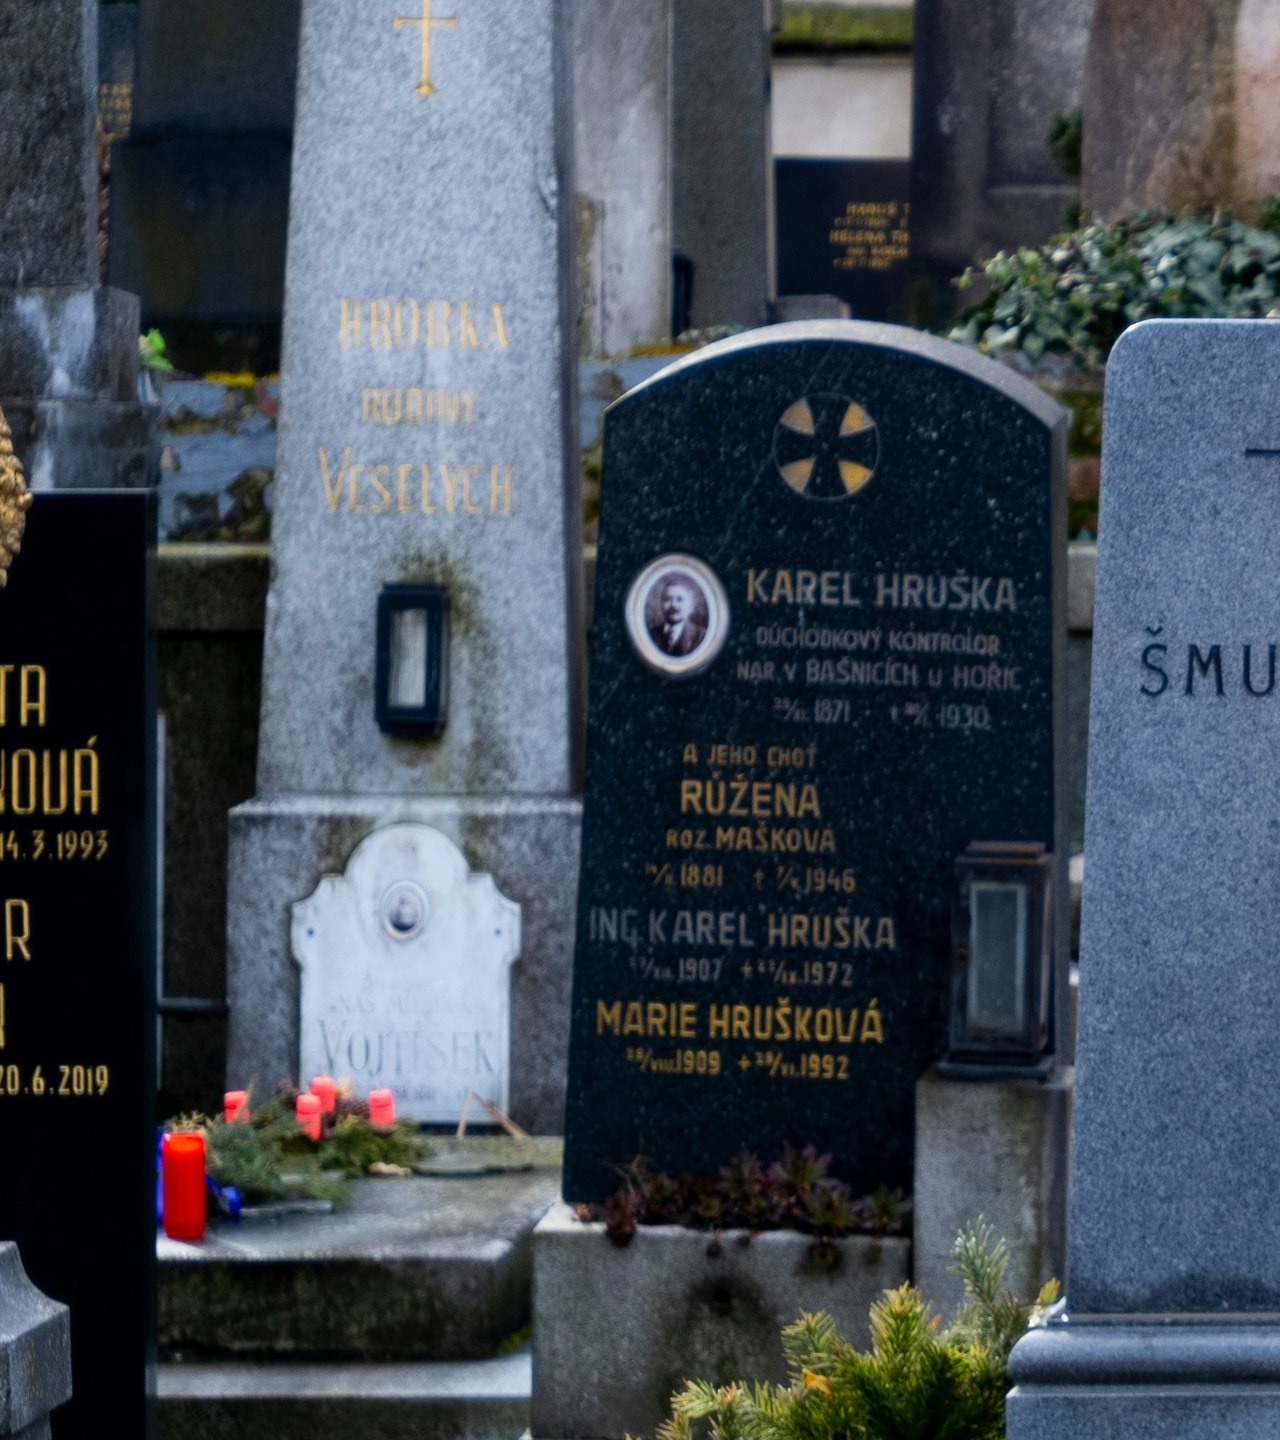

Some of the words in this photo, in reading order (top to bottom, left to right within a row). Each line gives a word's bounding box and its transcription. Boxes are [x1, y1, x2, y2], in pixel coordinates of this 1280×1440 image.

[339, 298, 508, 349] HROBKA
[361, 387, 480, 425] RODINY
[745, 568, 860, 606] KAREL
[875, 567, 1017, 611] HRUŠKA
[683, 743, 698, 765] A
[707, 744, 756, 767] JEHO
[650, 909, 754, 947] KAREL
[768, 906, 896, 950] HRUŠKA
[597, 999, 697, 1038] MARIE
[708, 996, 885, 1044] HRUŠKOVÁ
